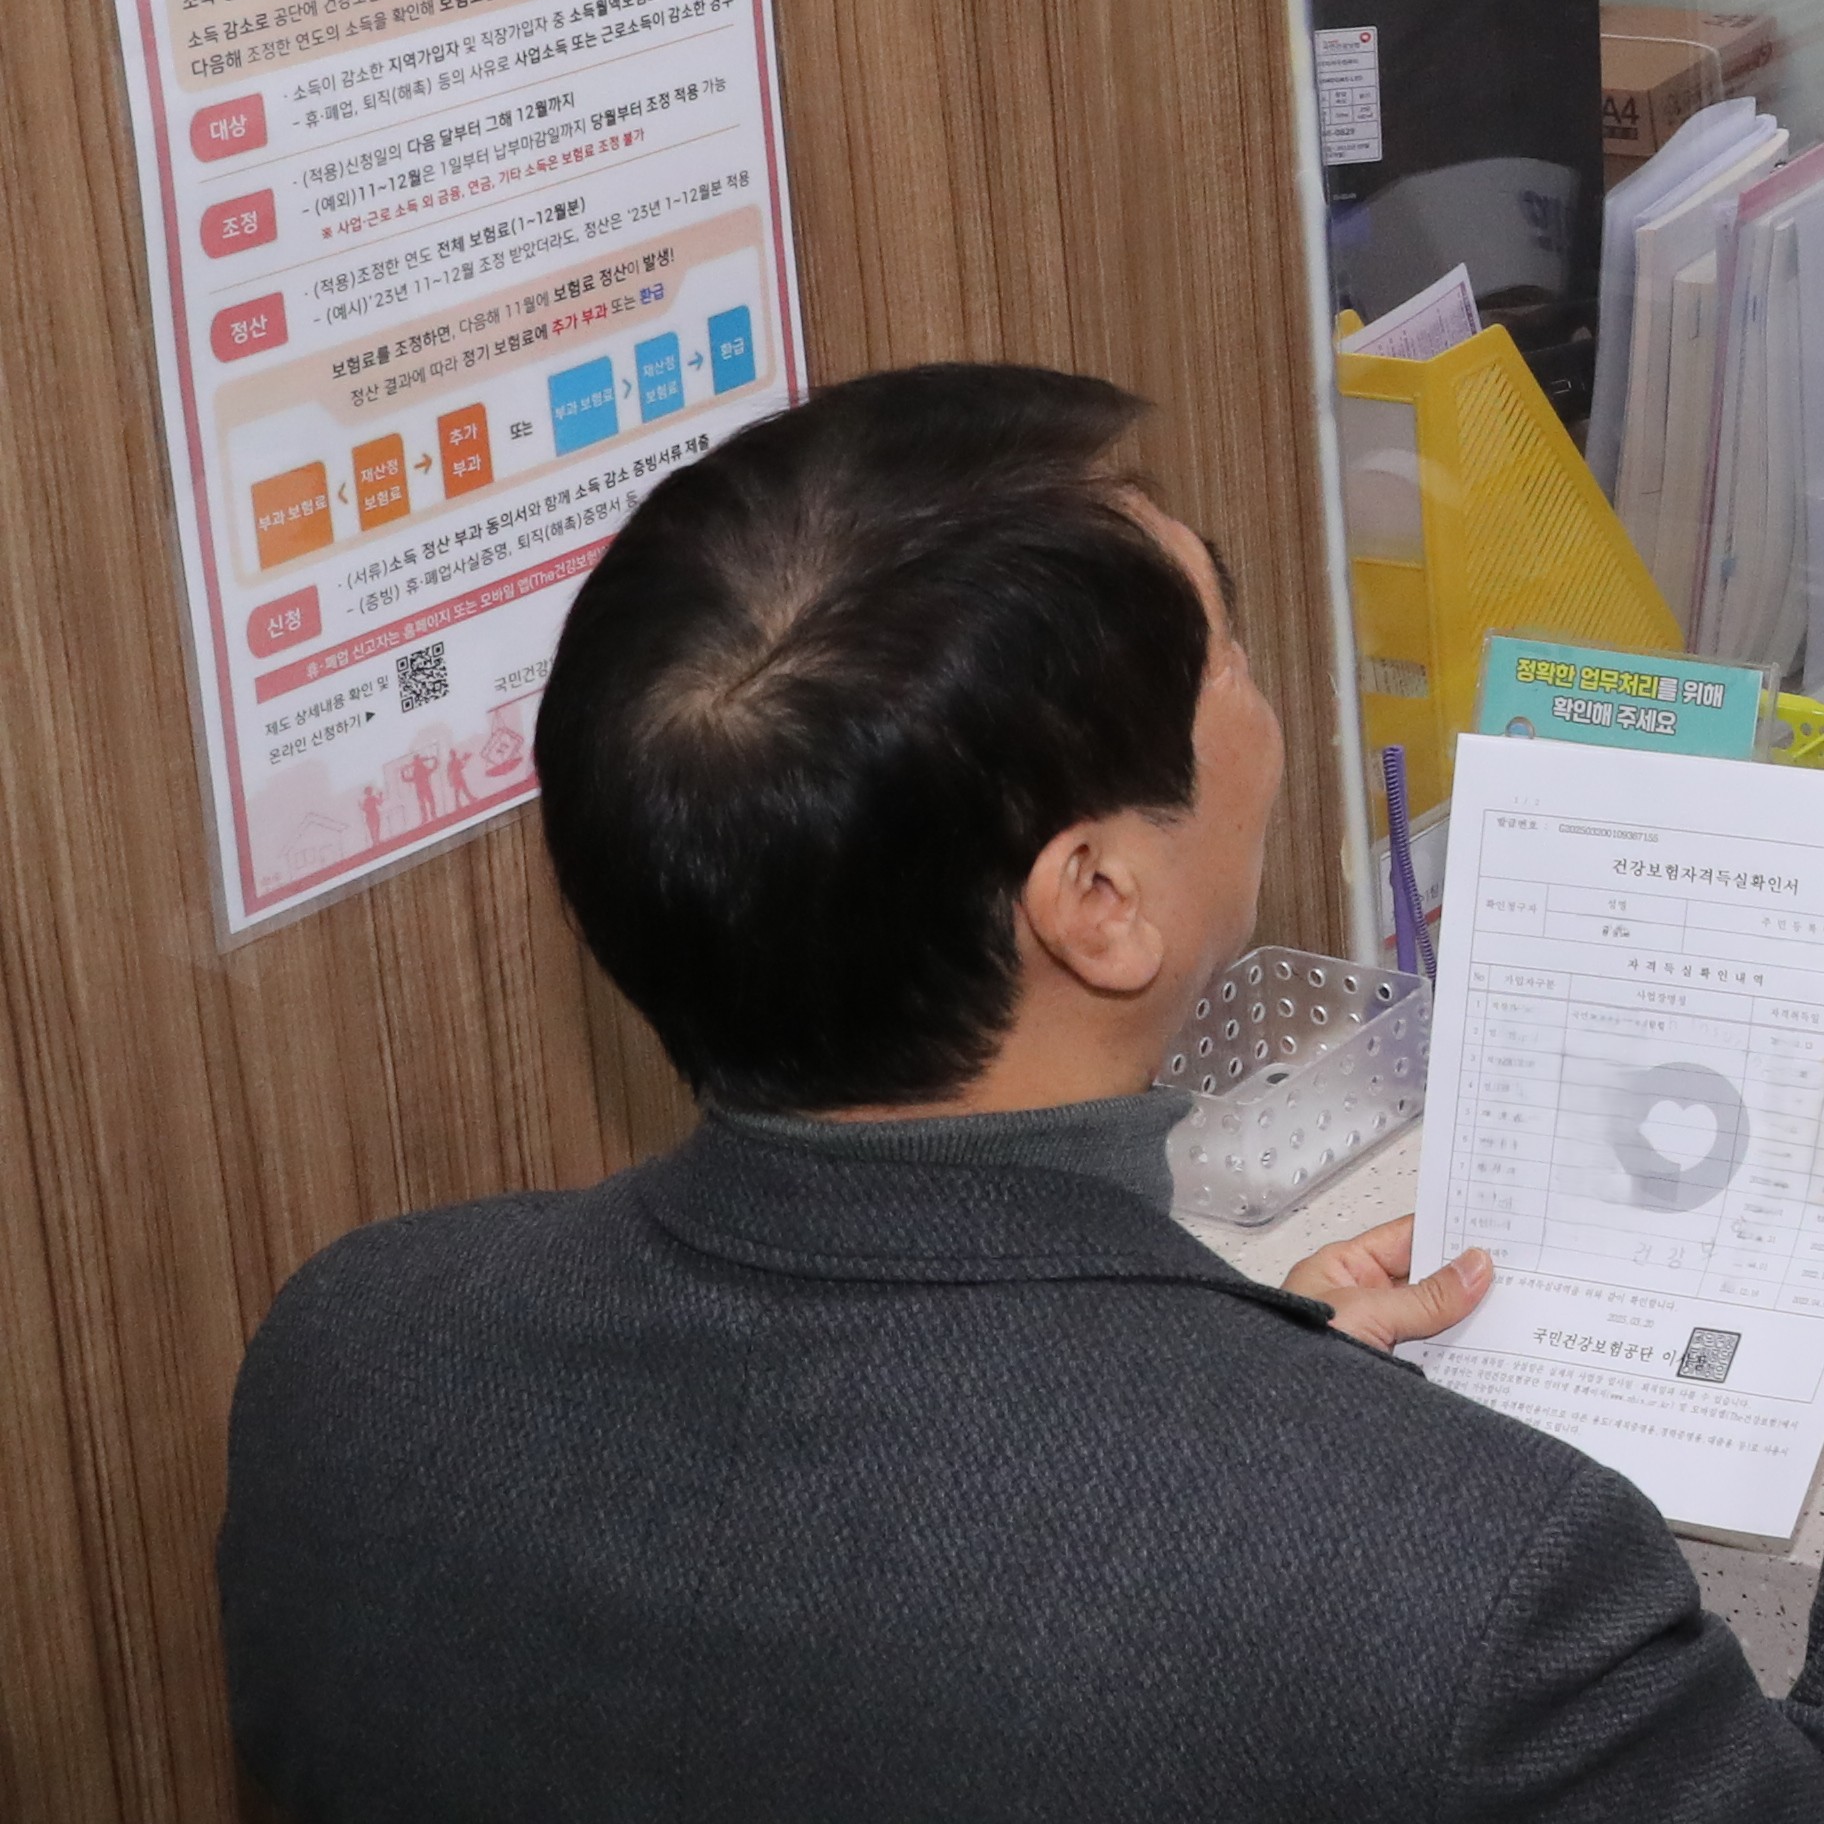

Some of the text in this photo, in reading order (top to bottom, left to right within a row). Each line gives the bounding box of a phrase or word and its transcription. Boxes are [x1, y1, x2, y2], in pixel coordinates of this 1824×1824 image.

[210, 115, 247, 139] 대상
[223, 211, 257, 238] 조정
[231, 315, 267, 343] 정산
[450, 423, 477, 445] 추가
[453, 455, 481, 477] 부과
[365, 486, 401, 510] 보험료
[268, 608, 301, 638] 신청
[1515, 658, 1726, 708] 정확한 업무처리를 위해
[1551, 696, 1678, 736] 확인해 주세요
[1614, 859, 1798, 895] 건강보험자격득실확인서
[1534, 1328, 1653, 1362] 국민건강보험공단
